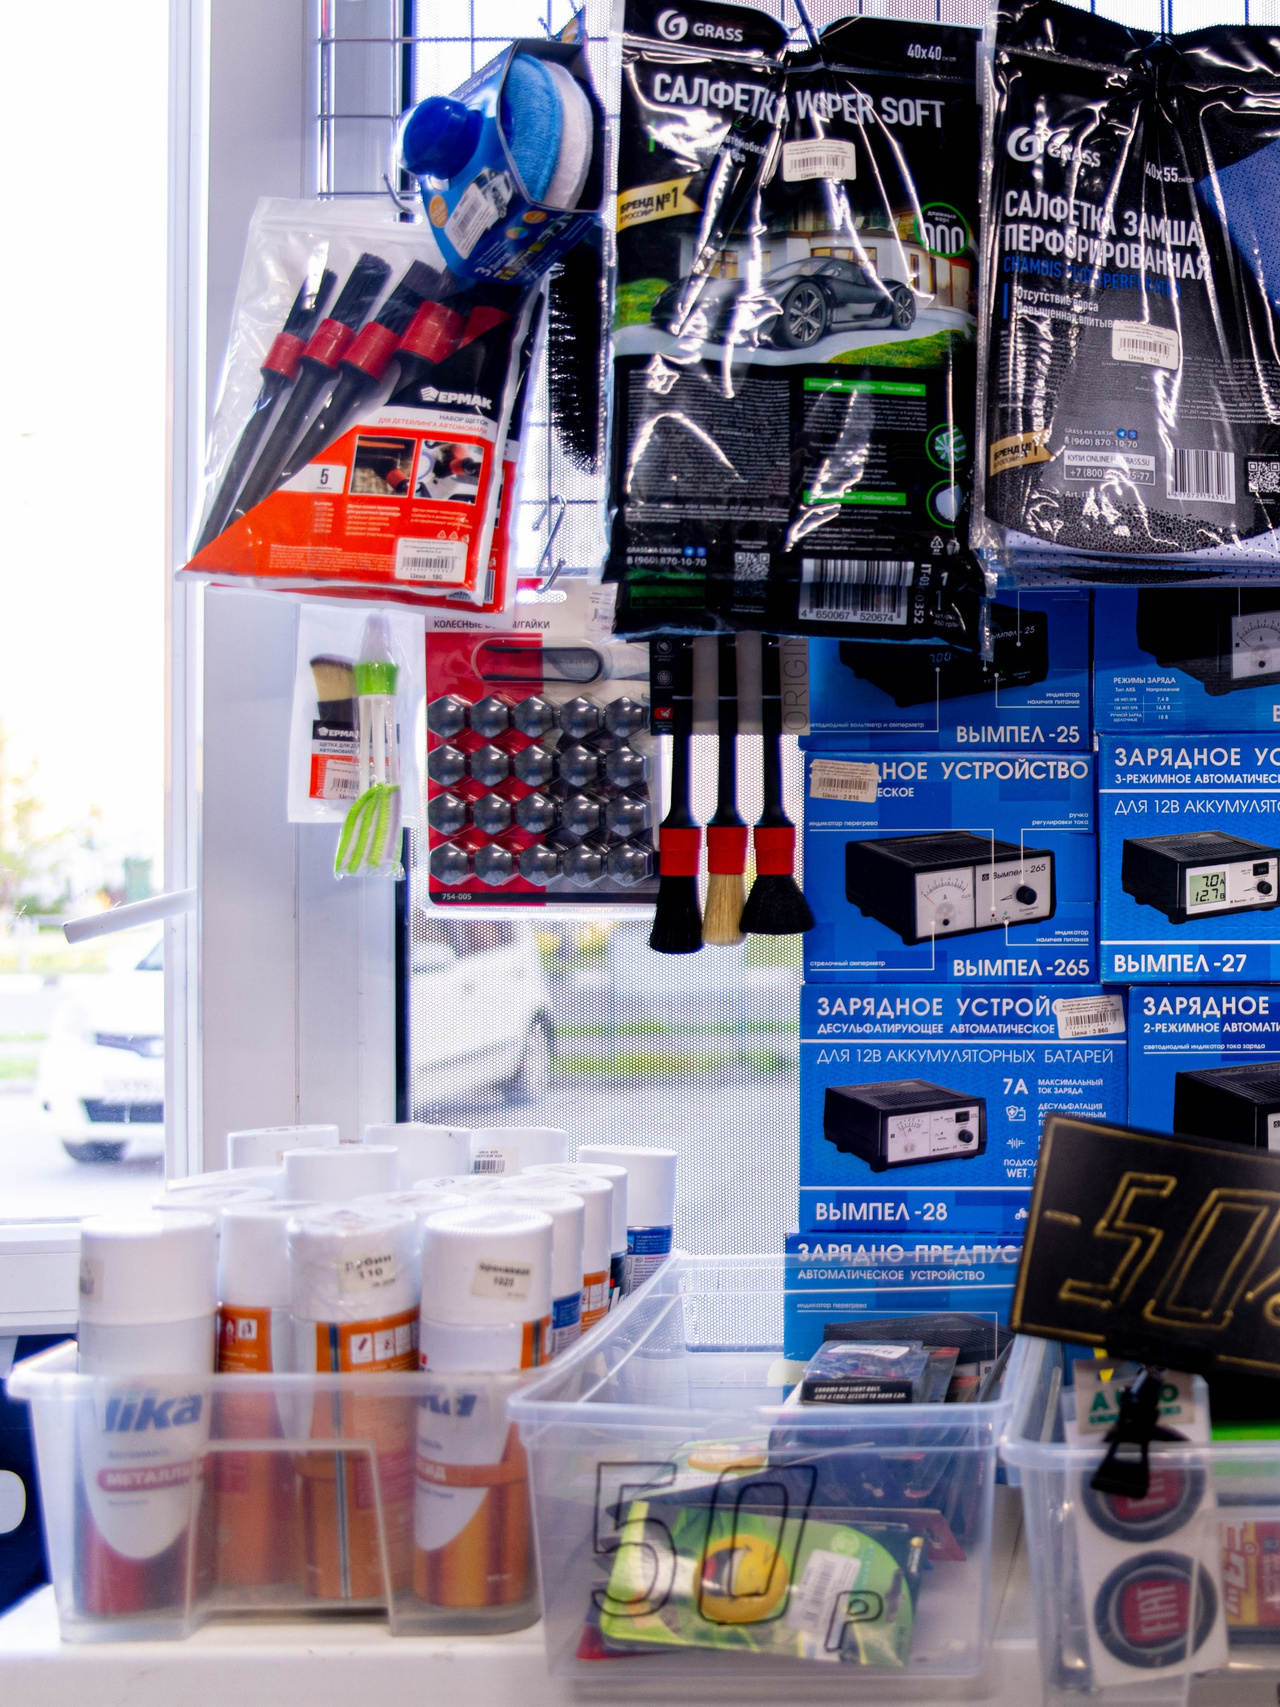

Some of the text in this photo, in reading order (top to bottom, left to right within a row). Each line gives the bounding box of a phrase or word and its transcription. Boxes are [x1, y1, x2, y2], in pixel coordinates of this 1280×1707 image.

[693, 22, 743, 42] GRASS
[654, 73, 790, 122] САЛФЕТКА
[795, 90, 945, 128] WIPER SOFT
[1047, 142, 1101, 167] GRASS
[1004, 190, 1203, 247] САЛФЕТКА ЗАМША
[1004, 224, 1210, 281] ПЕРФОРИРОВАННАЯ
[438, 391, 492, 409] ЕРМАК
[439, 415, 490, 428] НАБОР ЩЕТОК
[320, 468, 330, 486] 5
[1147, 677, 1176, 685] ЗАРЯДА
[957, 726, 1080, 743] ВЫМПЕЛ -25
[941, 759, 1088, 780] УСТРОЙСТВО
[1115, 773, 1191, 784] 3-РЕЖИМНОЕ
[1115, 800, 1148, 815] ДЛЯ
[1154, 800, 1180, 814] 12В
[442, 893, 472, 901] 754-005
[953, 959, 1090, 976] ВЫМПЕЛ -265
[1114, 954, 1247, 972] ВЫМПЕЛ -27
[817, 998, 943, 1019] ЗАРЯДНОЕ
[1143, 996, 1269, 1018] ЗАРЯДНОЕ
[817, 1023, 1055, 1035] ДЕСУЛЬФАТИРУЮЩЕЕ АВТОМАТИЧЕСКОЕ
[1144, 1022, 1219, 1033] 2-РЕЖИМНОЕ
[1038, 1103, 1103, 1111] ДЕСУЛЬФАТАЦИЯ
[816, 1202, 948, 1221] ВЫМПЕЛ -28
[797, 1269, 985, 1281] АВТОМАТИЧЕСКОЕ УСТРОЙСТВО
